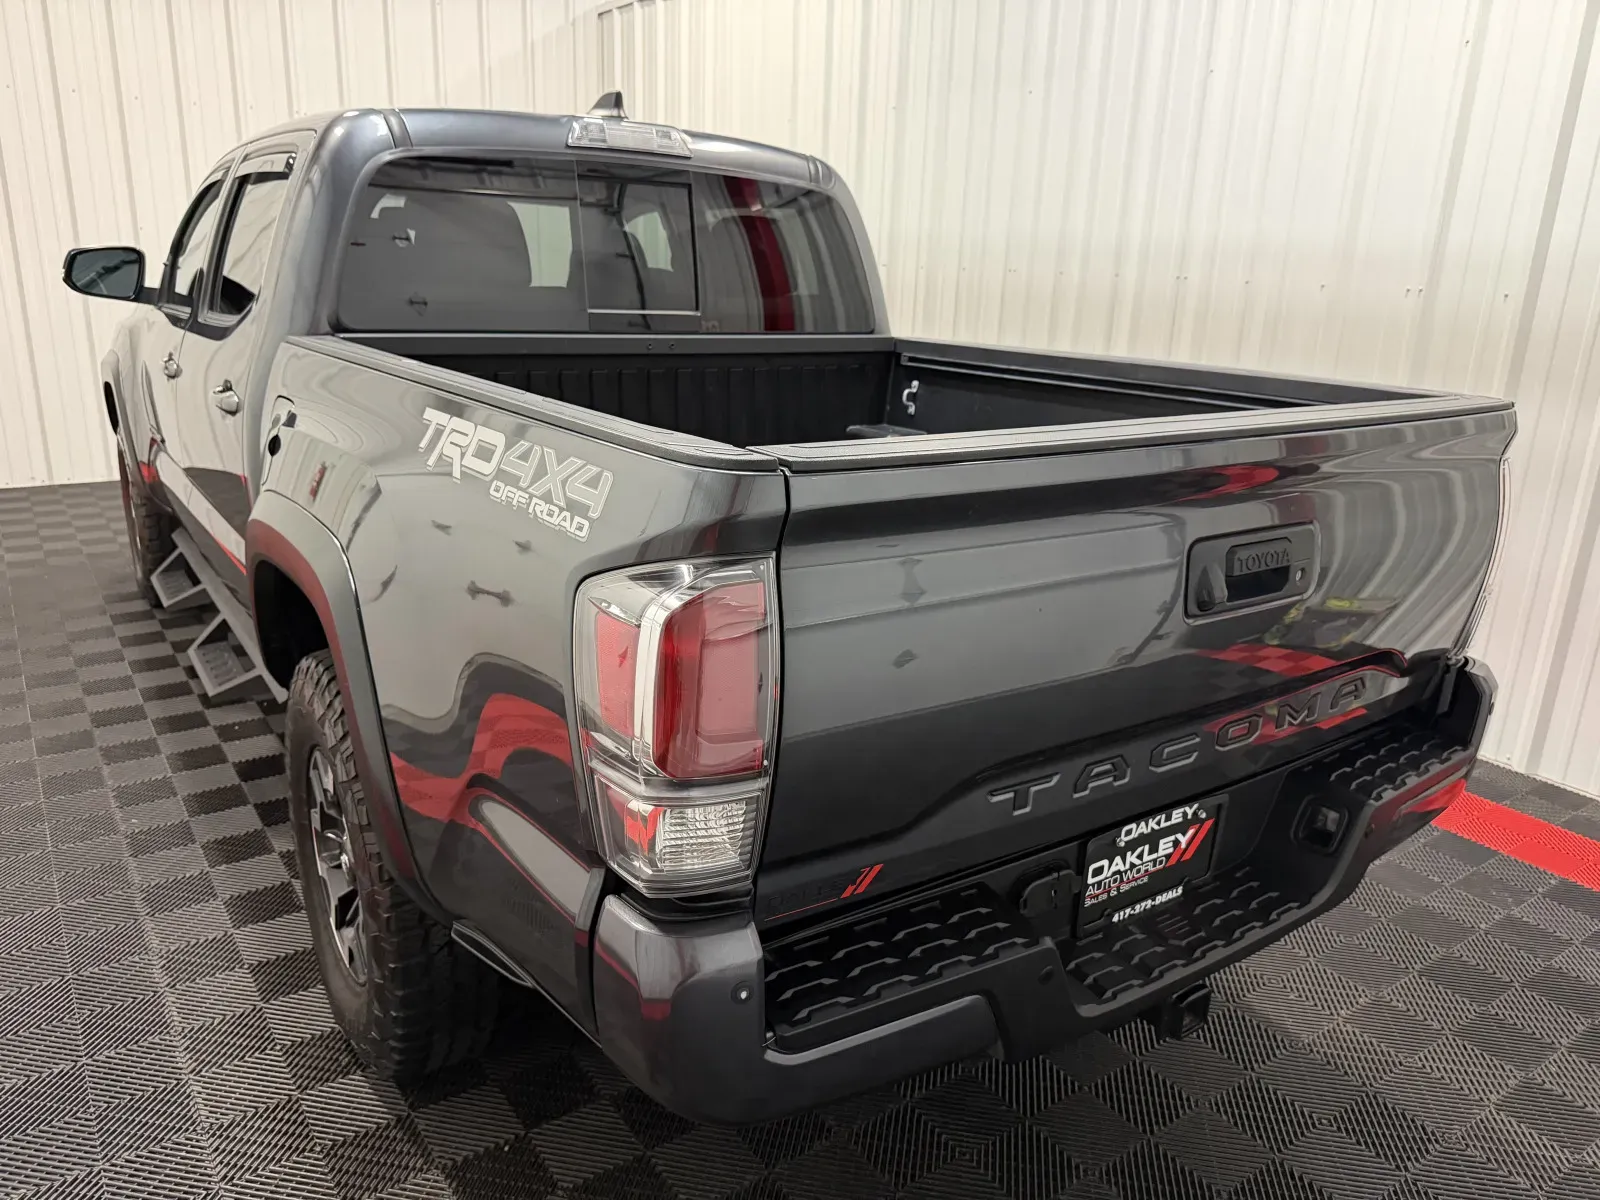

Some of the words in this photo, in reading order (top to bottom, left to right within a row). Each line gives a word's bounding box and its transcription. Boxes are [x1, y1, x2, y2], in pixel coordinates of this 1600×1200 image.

[419, 407, 506, 482] TRD
[489, 480, 530, 509] OFF
[528, 496, 590, 542] ROAD
[1235, 547, 1291, 573] TOYOTA
[986, 677, 1367, 816] TACOMA
[1120, 803, 1200, 842] OAKLEY
[1085, 875, 1121, 897] AUTO
[1122, 856, 1166, 882] WORLD
[1087, 828, 1196, 885] OAKLEY
[1110, 889, 1118, 897] &
[1112, 885, 1184, 923] 417-272-DEALS
